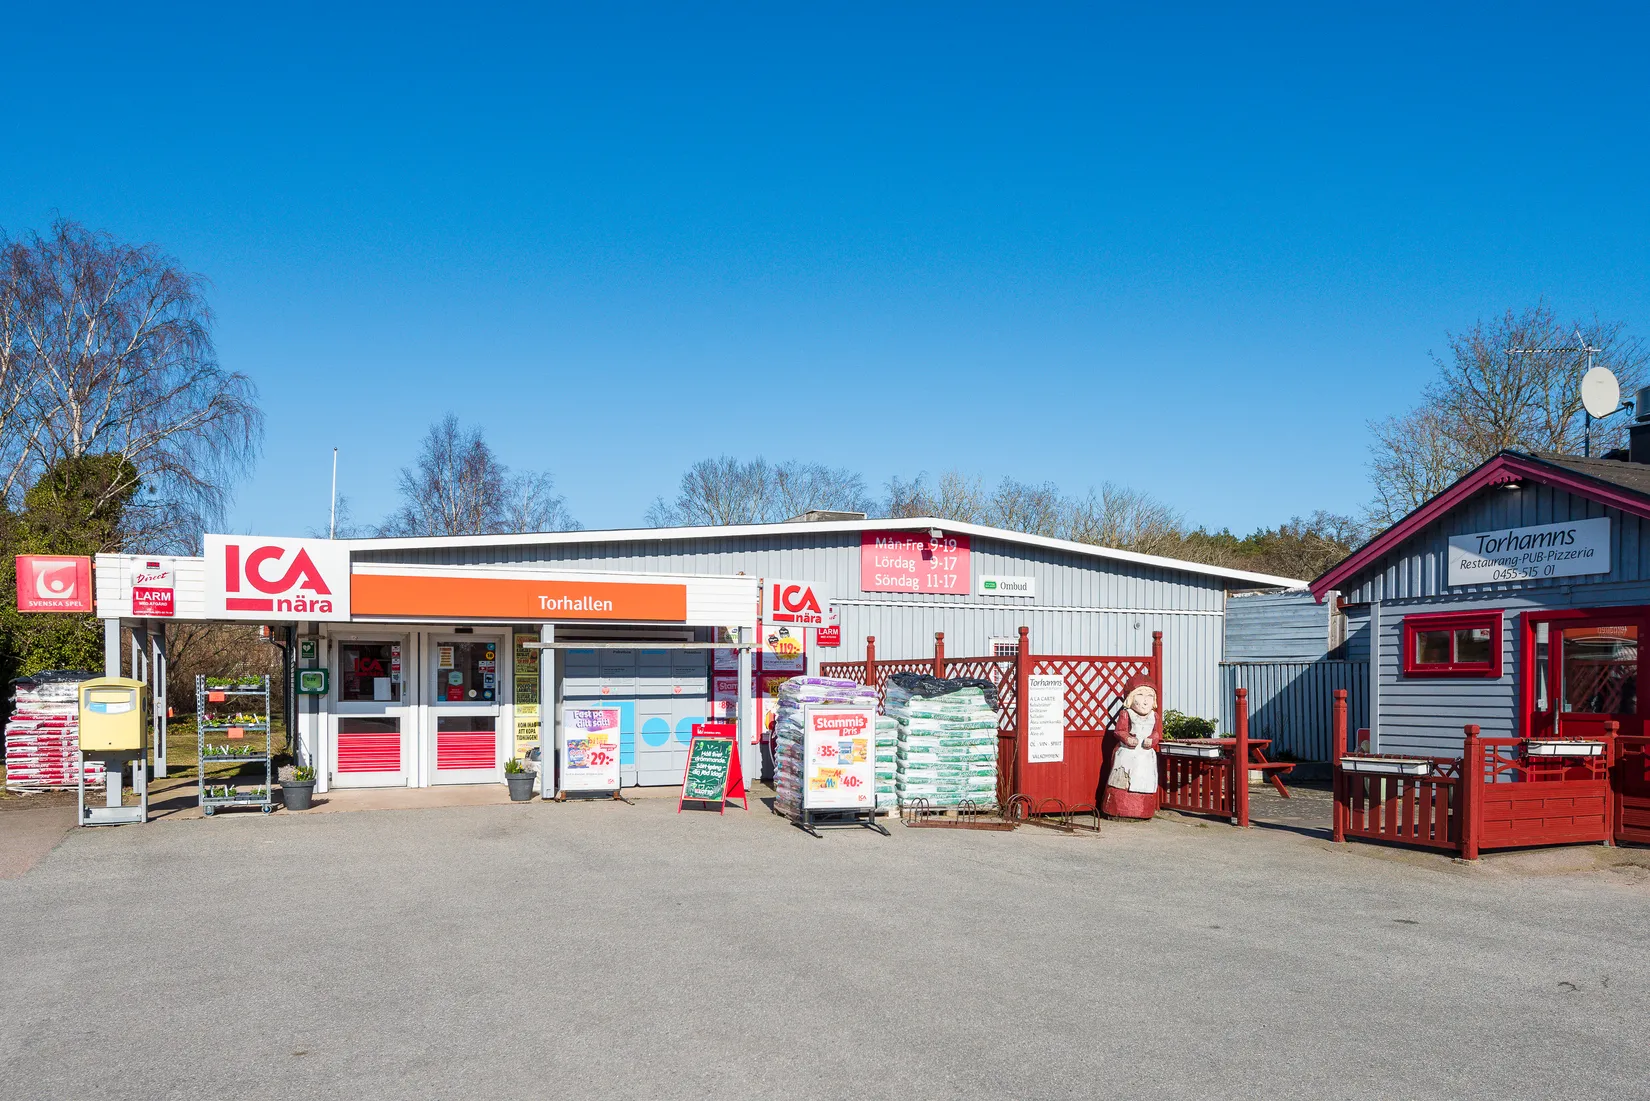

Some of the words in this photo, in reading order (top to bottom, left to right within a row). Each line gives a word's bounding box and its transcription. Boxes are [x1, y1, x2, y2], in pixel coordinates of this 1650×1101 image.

[875, 537, 924, 550] Mån-Fre
[930, 539, 957, 552] 9-19
[1476, 529, 1576, 554] Torhamns
[875, 556, 916, 572] Lördag
[930, 557, 957, 570] 9-17
[1460, 547, 1594, 569] Restaurang-PUB-Pizzeria
[226, 545, 332, 594] ICA
[1493, 566, 1538, 580] 0455-515
[1544, 565, 1555, 576] 01
[136, 572, 169, 584] Direct
[875, 574, 920, 590] Söndag
[927, 574, 957, 588] 11-17
[1000, 582, 1027, 590] Ombud
[136, 591, 170, 601] LARM
[773, 584, 822, 613] ICA
[278, 595, 332, 612] nära
[538, 596, 612, 611] Torhallen
[796, 612, 822, 624] nära
[779, 643, 800, 654] 119:-
[354, 657, 384, 671] ICA
[574, 711, 592, 719] Fest
[817, 716, 864, 728] Stammis
[821, 746, 838, 756] 35:-
[591, 752, 613, 765] 29:-
[843, 776, 862, 787] 40:-
